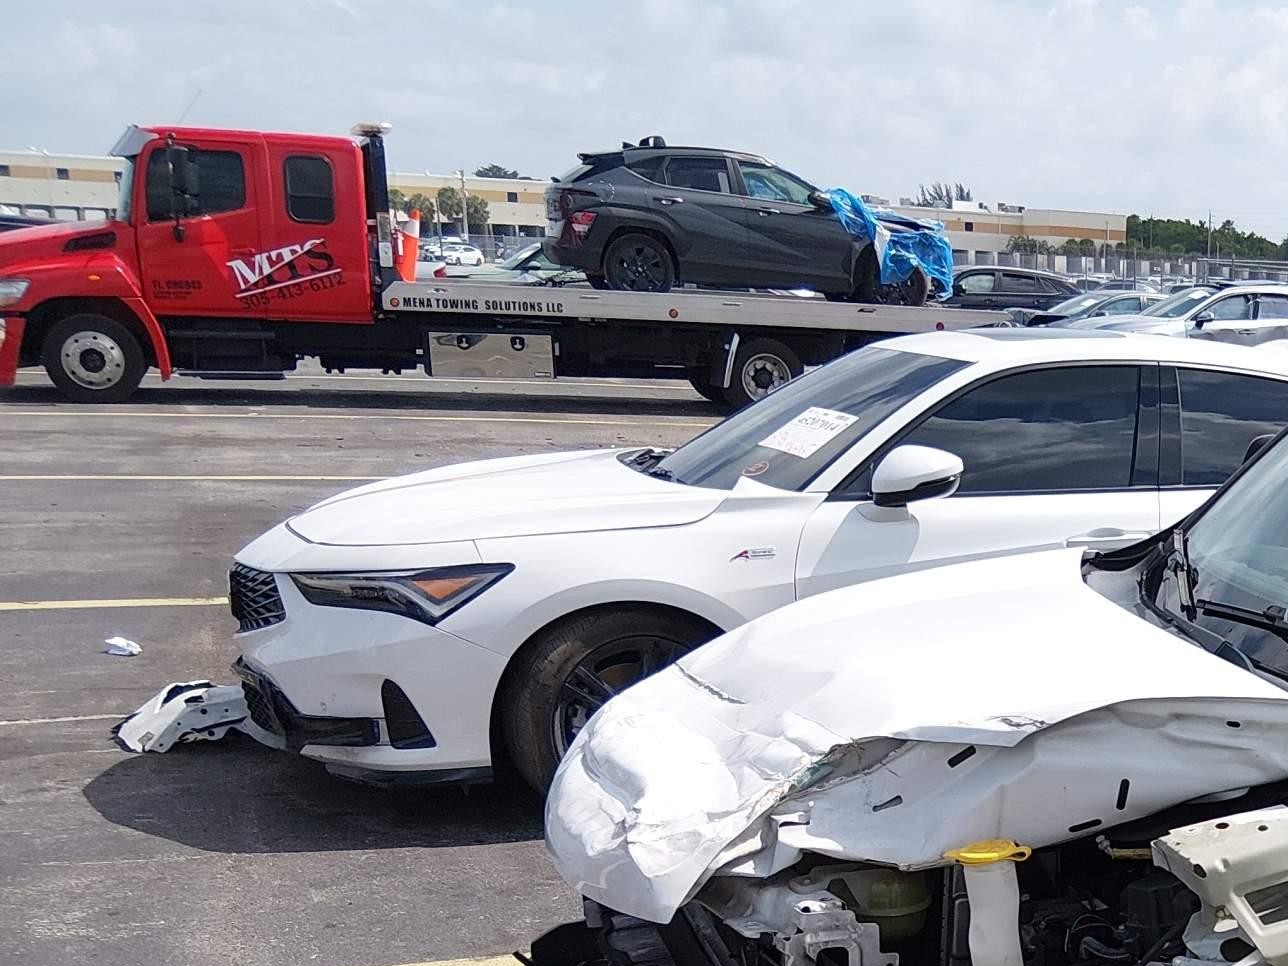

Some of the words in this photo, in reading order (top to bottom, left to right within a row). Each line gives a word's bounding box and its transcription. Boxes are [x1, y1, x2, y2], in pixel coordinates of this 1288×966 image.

[225, 238, 335, 290] MTS
[240, 273, 347, 309] 305-413-6112
[403, 297, 433, 308] MENA
[435, 298, 479, 310] TOWING
[485, 300, 543, 312] SOLUTIONS
[546, 302, 564, 313] LLC
